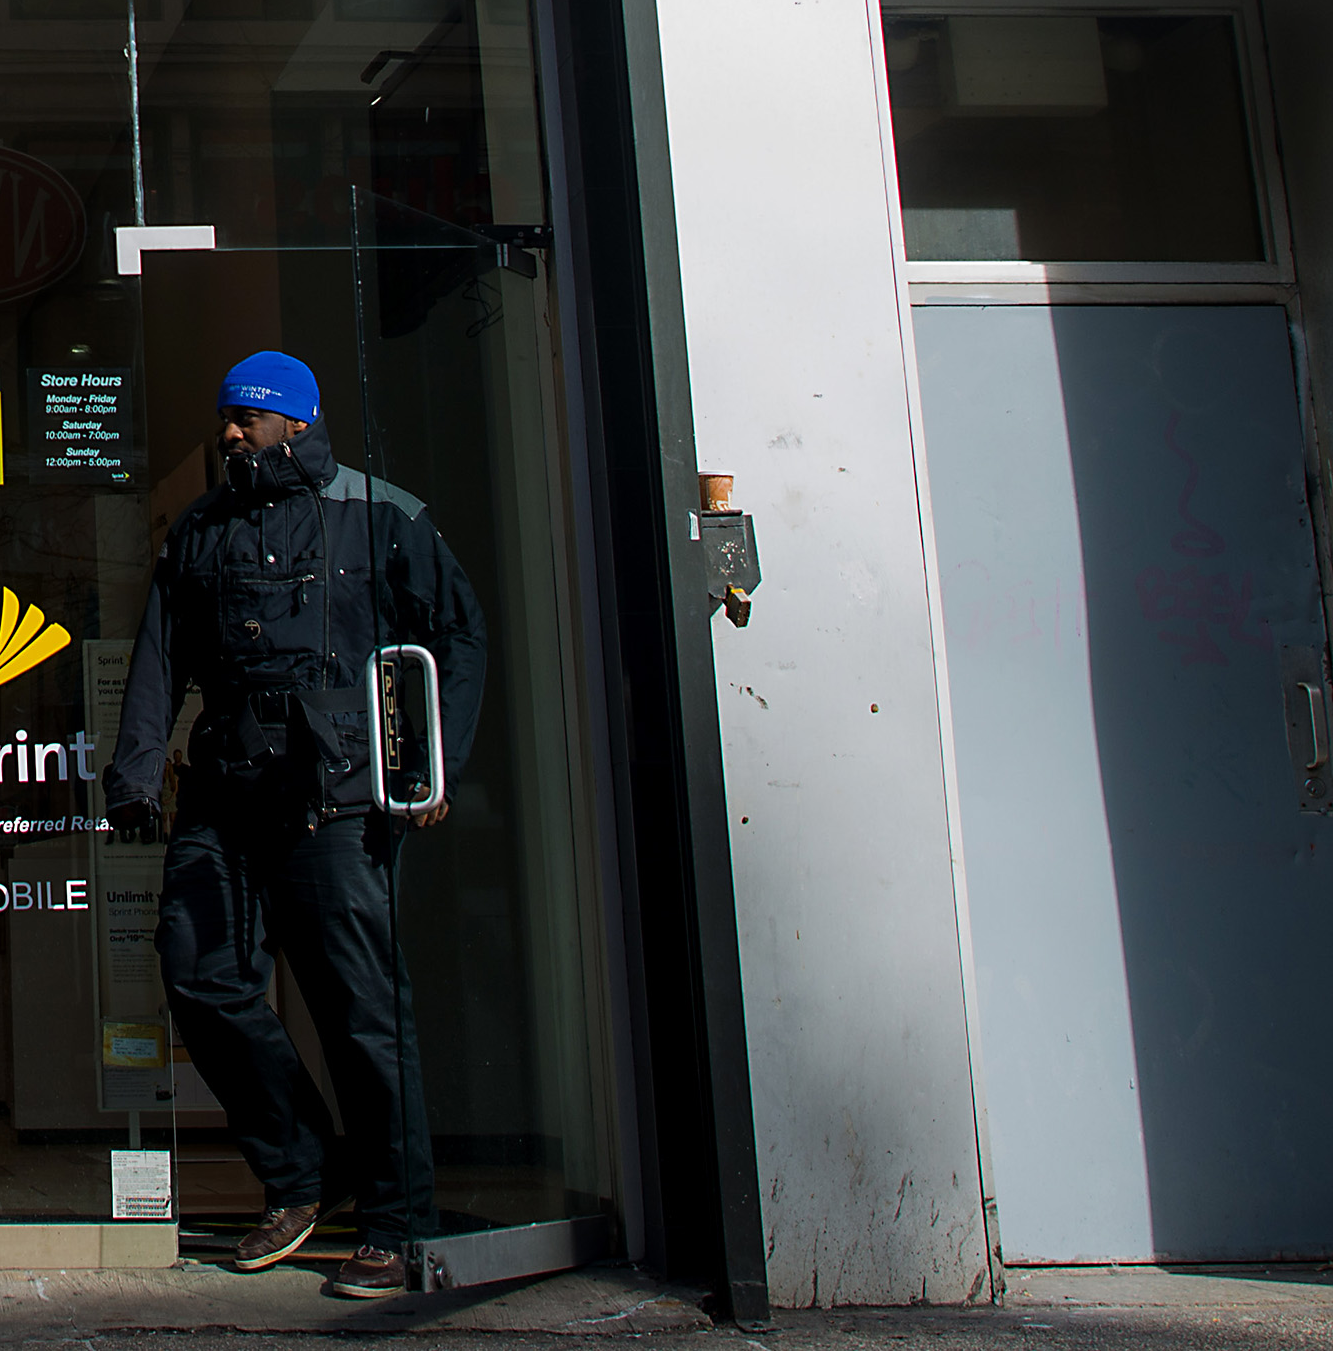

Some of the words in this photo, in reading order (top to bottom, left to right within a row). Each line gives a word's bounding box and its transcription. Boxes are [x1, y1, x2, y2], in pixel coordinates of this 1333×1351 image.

[40, 373, 78, 387] Store
[81, 373, 123, 387] Hours
[46, 394, 82, 404] Monday
[88, 394, 117, 404] Friday
[45, 405, 77, 414] 9:00am
[84, 405, 117, 415] 8:00pm
[62, 420, 102, 430] Saturday
[45, 431, 80, 440] 10:00am
[88, 431, 120, 441] 7:00pm
[65, 447, 100, 457] Sunday
[45, 458, 81, 468] 12:00pm
[88, 458, 121, 468] 5:00pm
[97, 655, 124, 667] Sprint
[98, 688, 113, 696] you
[384, 674, 396, 757] PULL
[70, 815, 115, 833] Reta
[106, 890, 154, 903] Unlimit
[108, 908, 132, 917] Sprint
